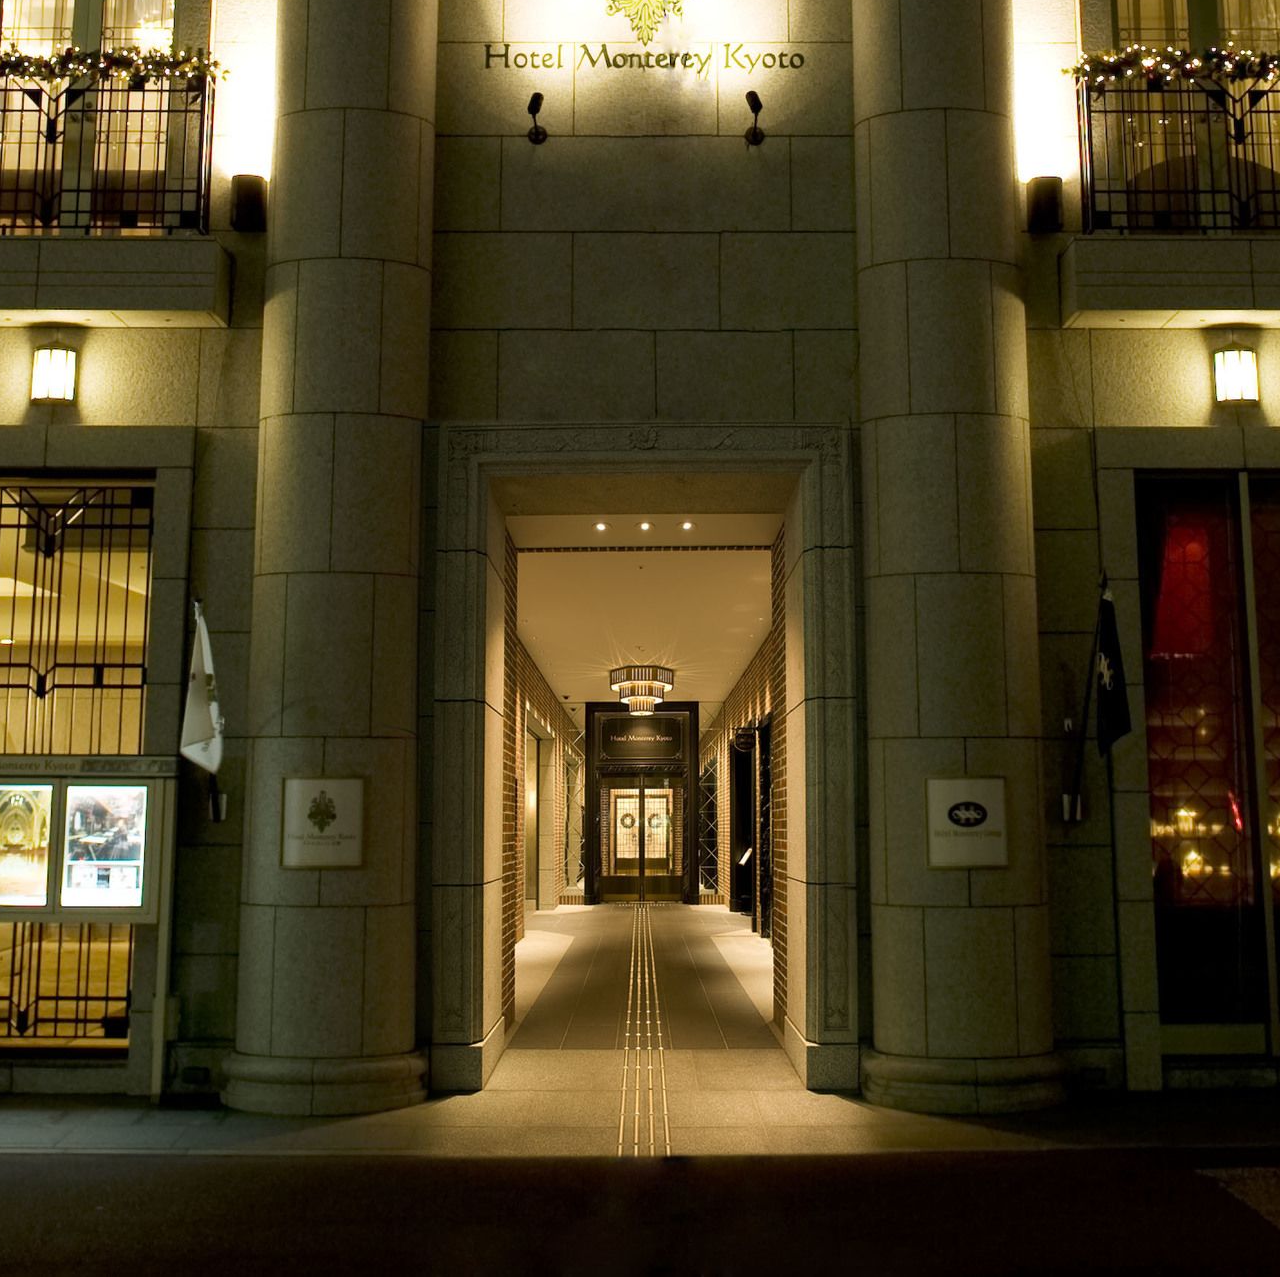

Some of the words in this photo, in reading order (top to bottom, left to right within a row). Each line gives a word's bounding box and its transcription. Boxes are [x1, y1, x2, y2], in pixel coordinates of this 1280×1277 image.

[484, 43, 564, 69] Hotel
[577, 43, 712, 74] Monterey
[723, 43, 805, 74] Kyoto
